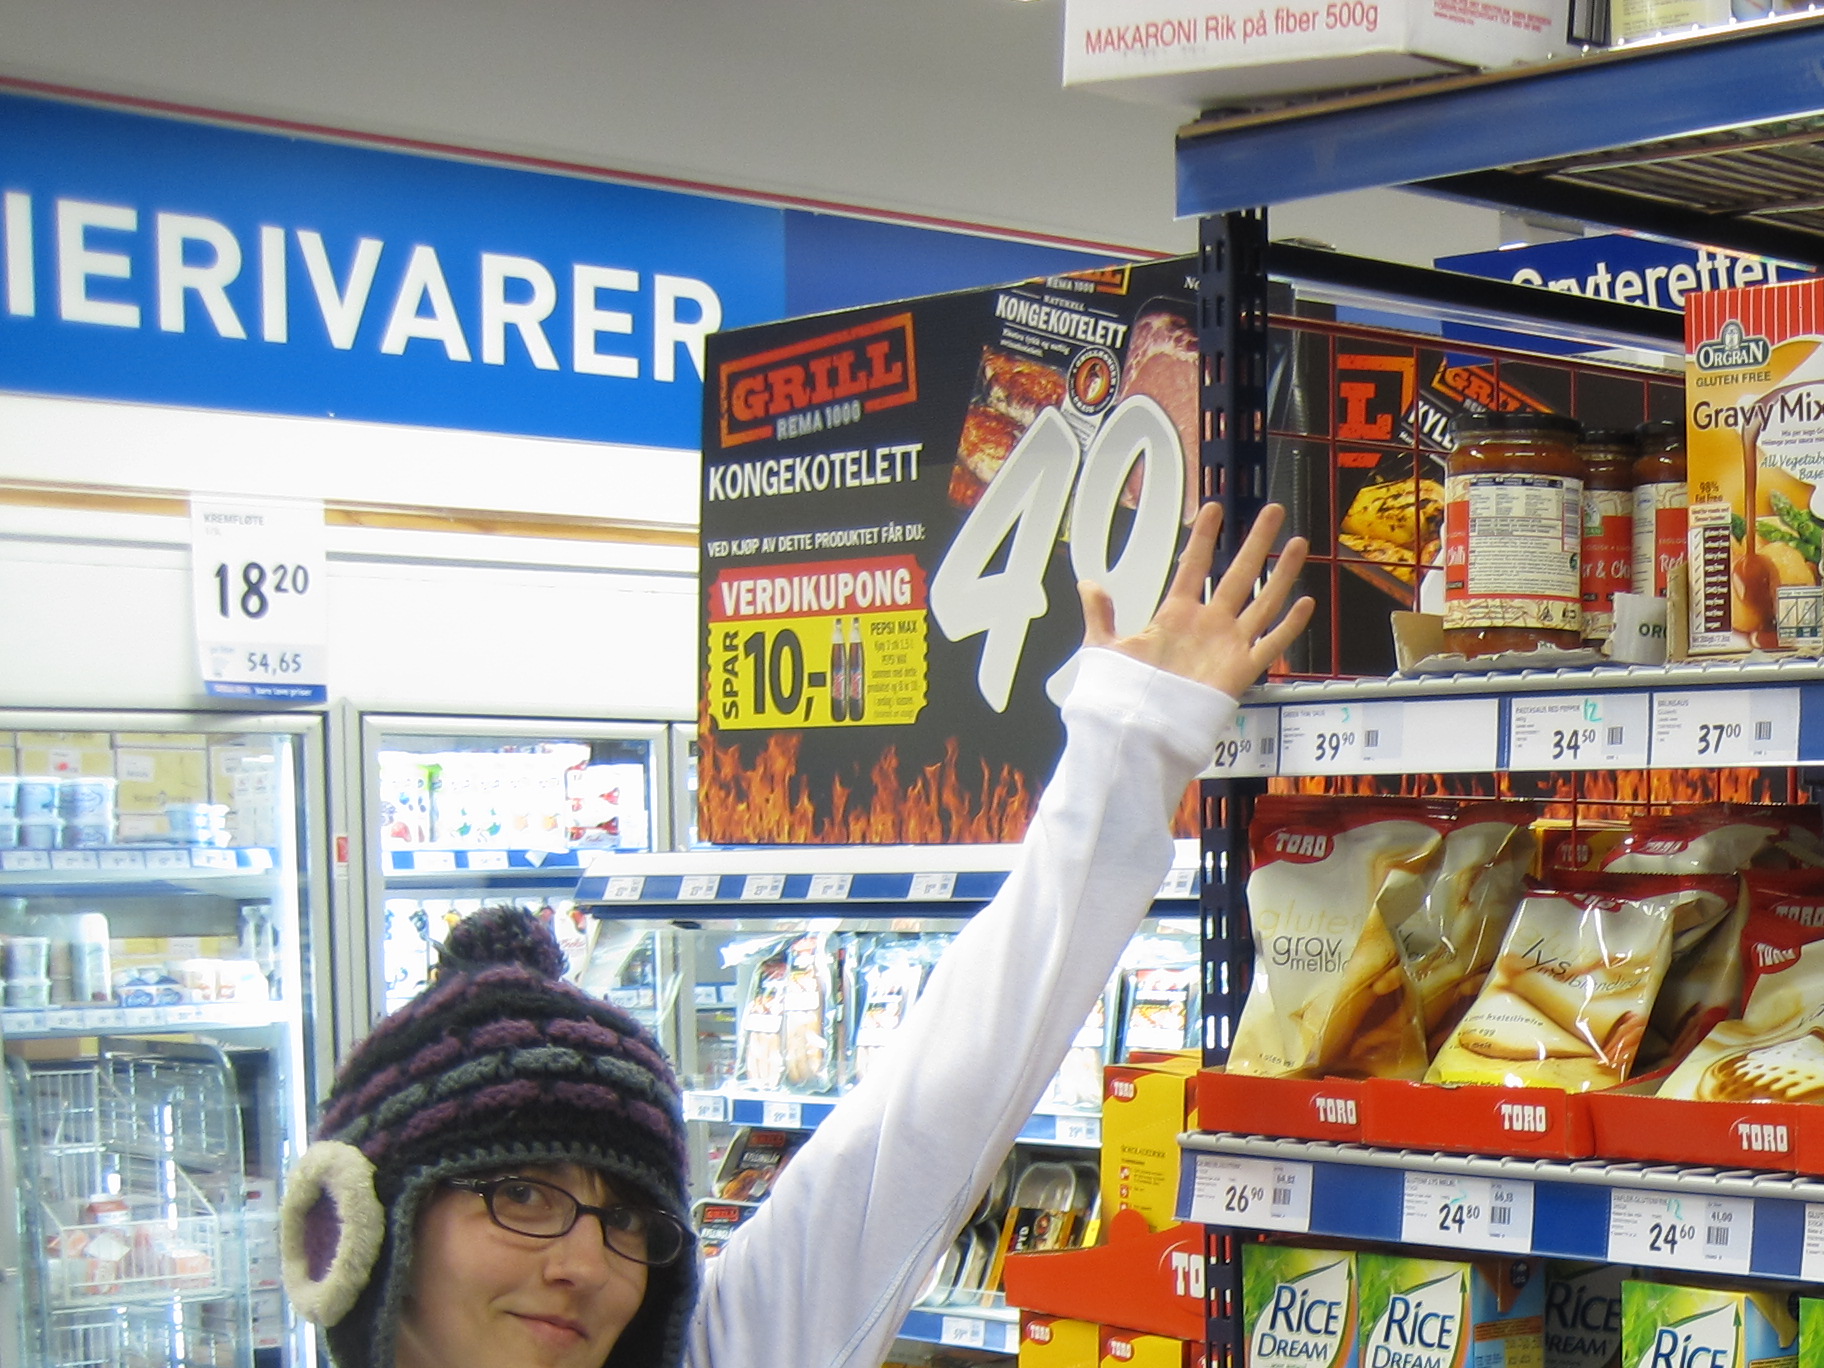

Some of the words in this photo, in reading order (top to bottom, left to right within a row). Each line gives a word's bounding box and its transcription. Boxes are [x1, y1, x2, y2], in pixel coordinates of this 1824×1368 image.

[1085, 15, 1198, 55] MAKARONI
[1204, 13, 1237, 43] Rik
[1242, 10, 1268, 39] på
[1274, 7, 1318, 35] fiber
[1323, 3, 1379, 34] 500g
[995, 294, 1129, 349] KONGEKOTELETT
[1698, 340, 1765, 368] ORGRAN
[731, 340, 903, 423] GRILL
[1696, 374, 1739, 388] GLUTEN
[1741, 370, 1771, 384] FREE
[775, 409, 823, 442] REMA
[825, 399, 863, 429] 1000
[1693, 400, 1775, 432] Gravy
[708, 443, 924, 503] KONGEKOTELETT
[1761, 454, 1777, 468] All
[708, 540, 729, 558] VED
[731, 537, 760, 557] KJØP
[762, 536, 775, 553] AV
[778, 532, 813, 553] DETTE
[815, 527, 880, 550] PRODUKTET
[881, 521, 903, 543] FÅR
[720, 567, 913, 617] VERDIKUPONG
[870, 621, 895, 636] PEPSI
[898, 619, 919, 634] MAX
[723, 629, 739, 720] SPAR
[1275, 832, 1327, 859] TORO
[1272, 934, 1343, 966] grov
[1315, 1096, 1358, 1125] TORO
[1500, 1102, 1547, 1133] TORO
[1737, 1123, 1789, 1153] TORO
[1257, 1332, 1329, 1362] DREAM
